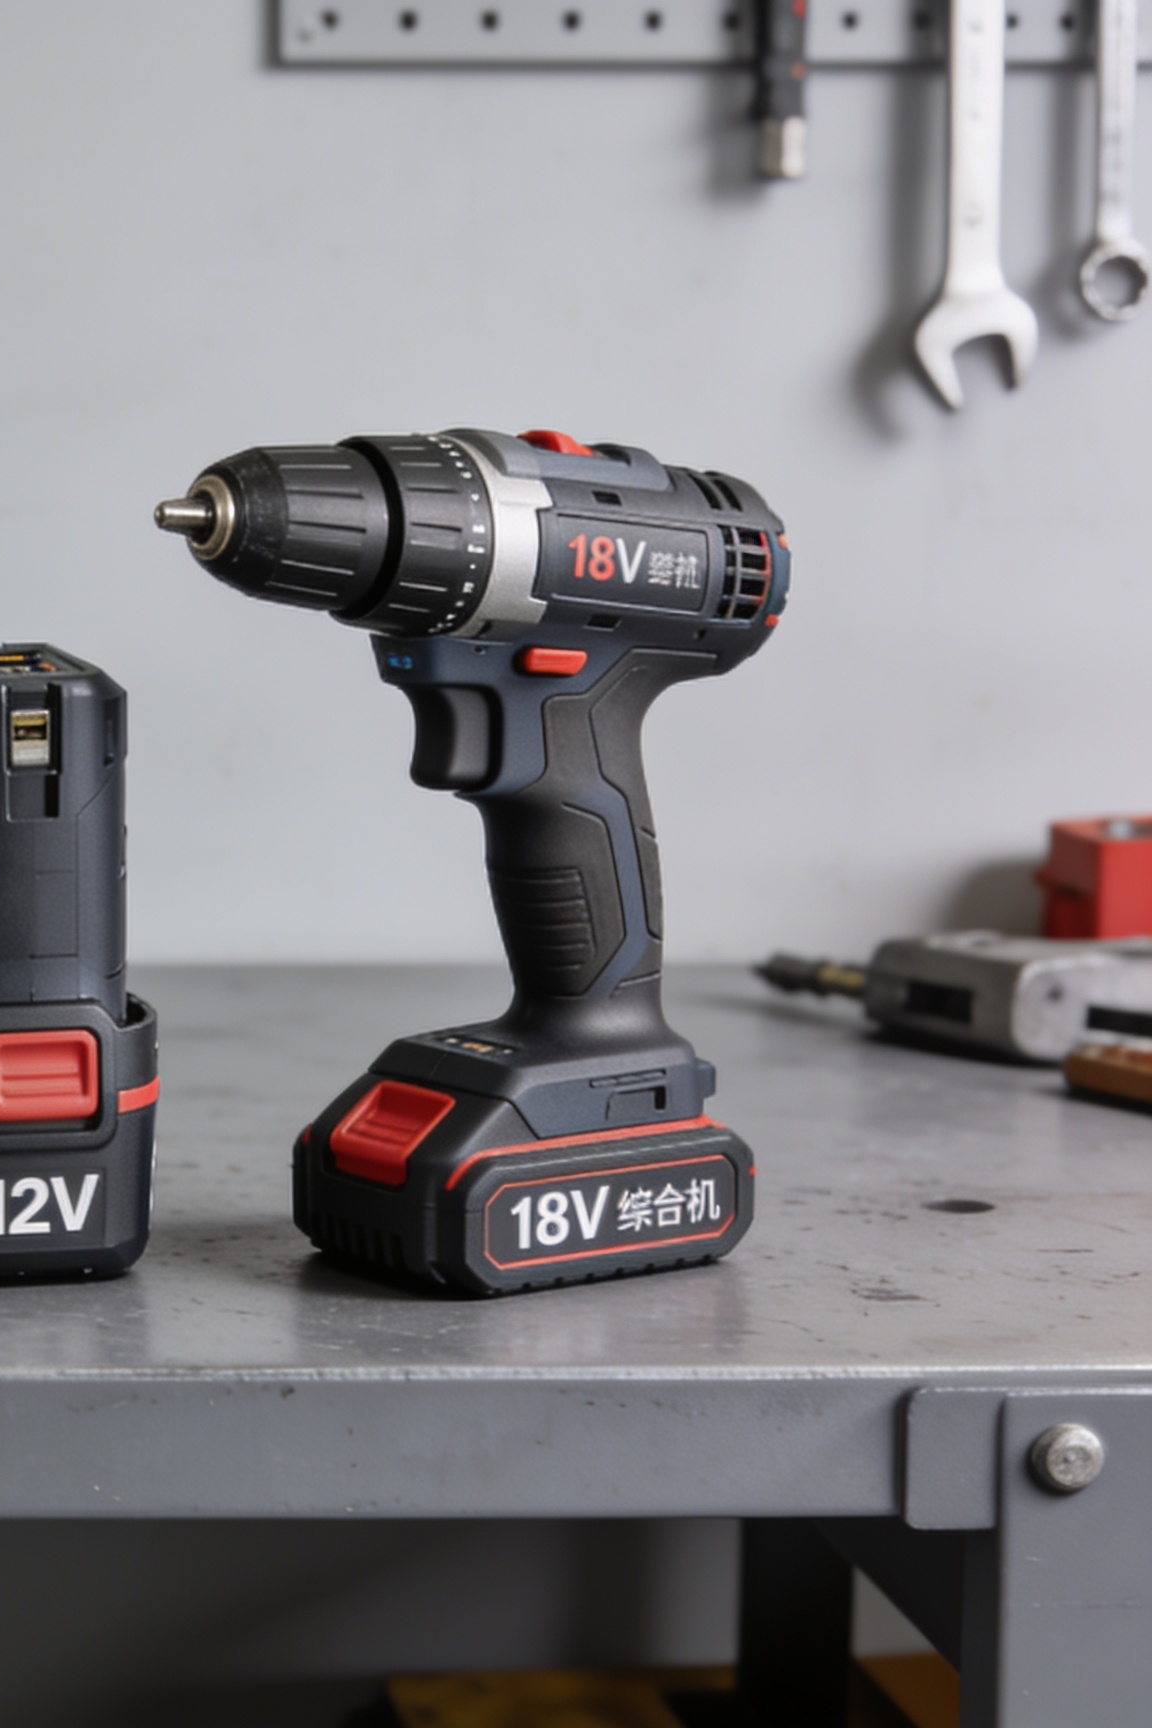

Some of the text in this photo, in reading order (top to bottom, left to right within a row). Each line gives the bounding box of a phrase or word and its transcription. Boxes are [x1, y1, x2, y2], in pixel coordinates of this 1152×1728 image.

[568, 533, 647, 584] 18V
[510, 1178, 721, 1250] 18V 综合机
